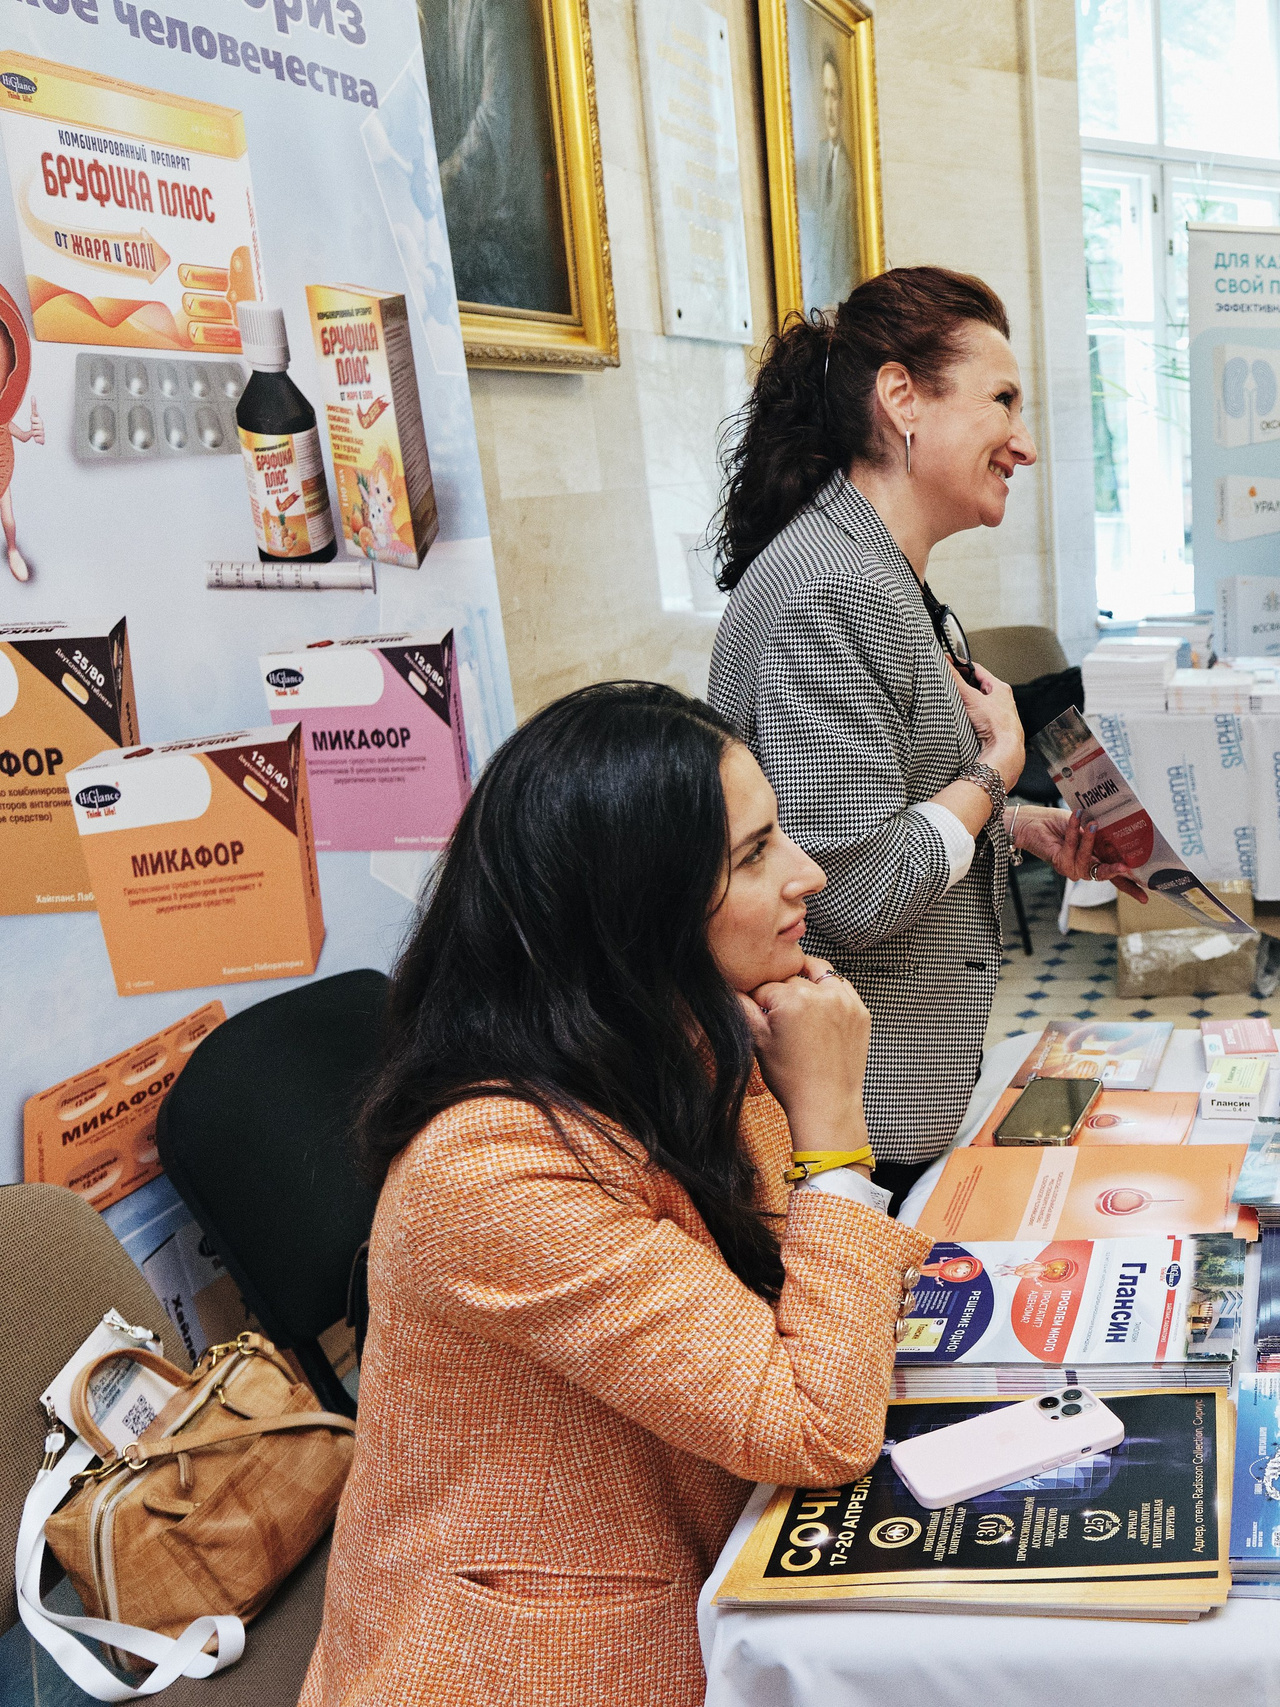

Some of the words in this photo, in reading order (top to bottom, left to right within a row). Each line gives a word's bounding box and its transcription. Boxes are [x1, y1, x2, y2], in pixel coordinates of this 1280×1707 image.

[244, 0, 366, 45] риз
[113, 1, 379, 109] человечества
[58, 129, 147, 162] КОМБИНИРОВАННЫЙ
[150, 149, 191, 171] ПРЕПАРАТ
[41, 151, 154, 213] БРУФИКА
[157, 178, 216, 223] ПЛЮС
[55, 231, 68, 249] ОТ
[71, 233, 112, 263] ЖАРА
[124, 241, 156, 272] БОЛИ
[1214, 252, 1250, 271] ДЛЯ
[1215, 273, 1264, 294] СВОЙ
[321, 322, 379, 355] БРУФИКА
[335, 356, 371, 386] ПЛЮС
[256, 448, 293, 471] БРУФИКА
[265, 469, 288, 488] ПЛЮС
[72, 649, 105, 687] 25/80
[414, 651, 444, 687] 12,5/80
[312, 727, 411, 751] МИКАФОР
[251, 750, 289, 789] 12,5/40
[78, 788, 121, 810] HiGlance
[1075, 779, 1119, 809] Глансин
[1167, 764, 1204, 858] SHPHARMA
[131, 840, 245, 878] МИКАФОР
[62, 1071, 175, 1147] МИКАФОР
[1211, 1099, 1250, 1107] Глансин
[961, 1290, 982, 1328] РЕШЕНИЕ
[1019, 1290, 1034, 1324] АДЕНОМА?
[1032, 1290, 1052, 1329] ПРОСТАТИТ?
[1052, 1290, 1072, 1328] ПРОБЛЕМ
[1105, 1262, 1147, 1343] Глансин
[945, 1328, 966, 1353] ОДНО!
[1043, 1326, 1060, 1353] МНОГО
[1193, 1399, 1206, 1426] Сириус
[1193, 1427, 1204, 1465] Collection,
[1193, 1466, 1203, 1499] Radisson
[842, 1476, 873, 1530] АПРЕЛЯ
[1153, 1499, 1163, 1542] ГЕНИТАЛЬНАЯ
[922, 1511, 941, 1553] ЮБИЛЕЙНЫЙ
[948, 1524, 963, 1555] КОНГРЕСС
[957, 1507, 967, 1523] ПААР
[976, 1521, 999, 1537] 30
[1016, 1496, 1036, 1562] ПРОФЕССИОНАЛЬНОЙ
[1031, 1507, 1046, 1549] АССОЦИАЦИИ
[1044, 1507, 1058, 1547] АНДРОЛОГОВ
[1058, 1514, 1070, 1539] РОССИИ
[1083, 1517, 1105, 1533] 25
[1127, 1509, 1138, 1540] ЖУРНАЛУ
[1192, 1522, 1206, 1553] Адлер,
